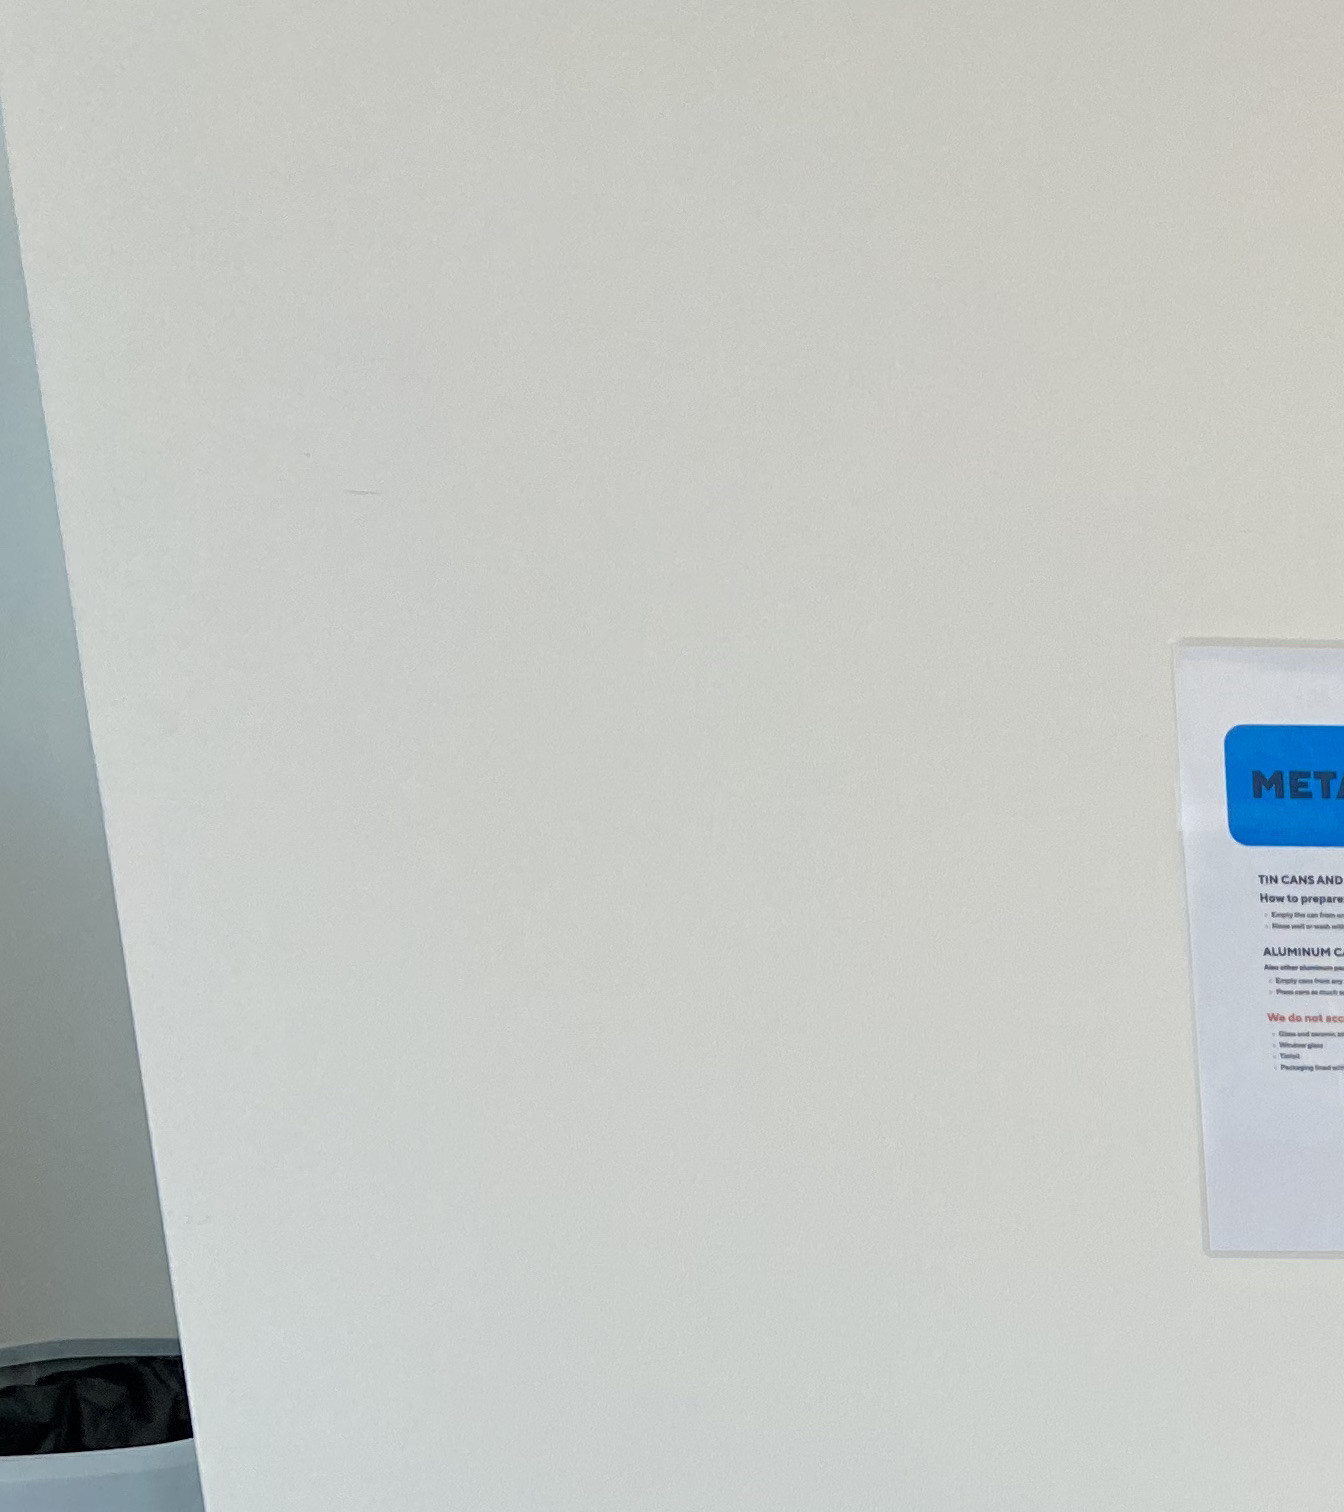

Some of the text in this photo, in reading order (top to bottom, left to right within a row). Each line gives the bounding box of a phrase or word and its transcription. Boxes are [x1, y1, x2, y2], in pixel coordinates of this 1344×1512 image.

[1258, 875, 1278, 885] TIN
[1281, 875, 1315, 885] CANS
[1317, 875, 1343, 885] AND
[1260, 893, 1285, 903] How
[1287, 895, 1299, 903] to
[1263, 947, 1331, 957] ALUMINUM
[1267, 1013, 1286, 1022] We
[1288, 1013, 1303, 1022] do
[1305, 1014, 1323, 1023] not
